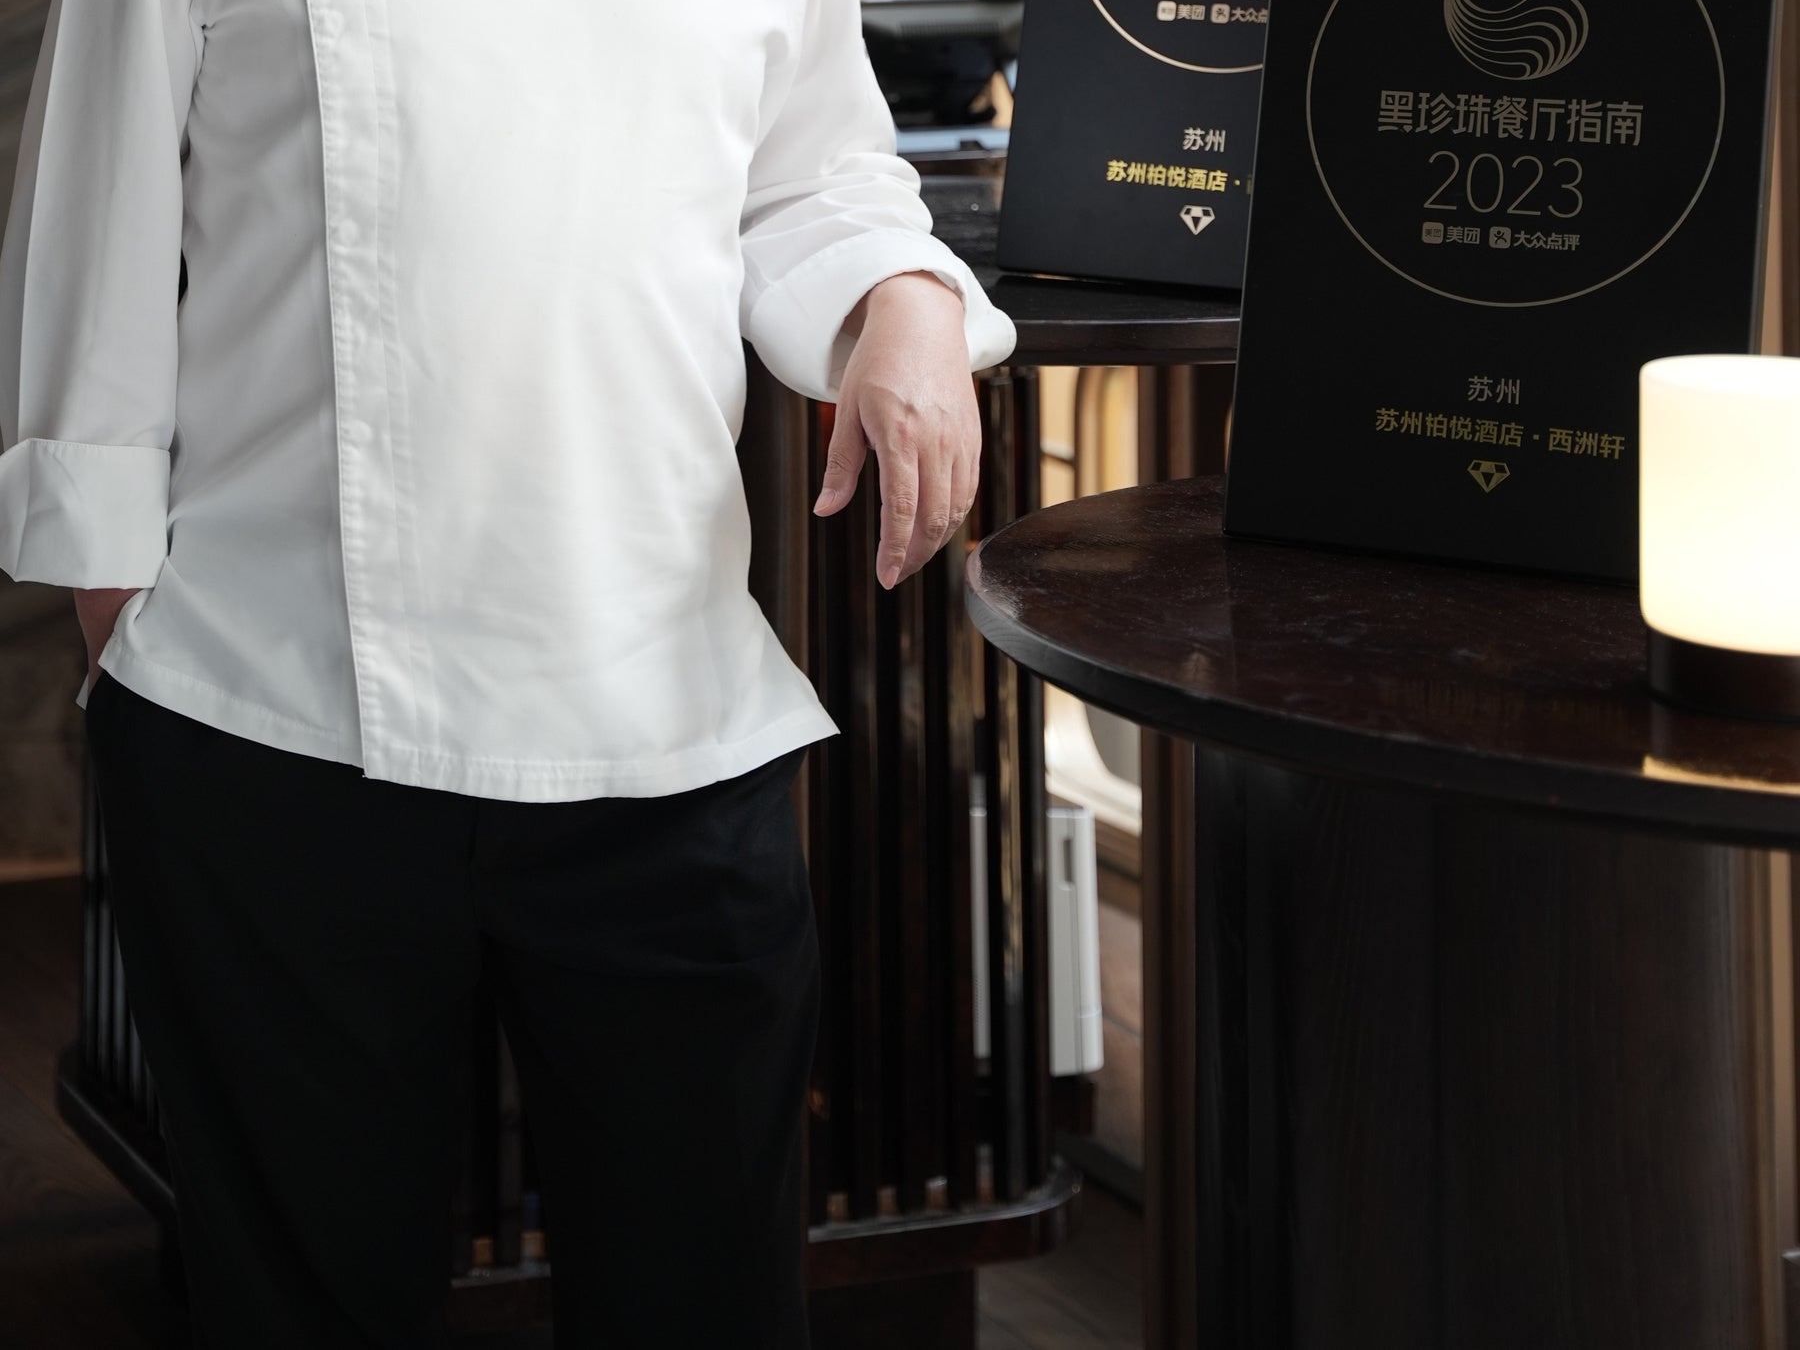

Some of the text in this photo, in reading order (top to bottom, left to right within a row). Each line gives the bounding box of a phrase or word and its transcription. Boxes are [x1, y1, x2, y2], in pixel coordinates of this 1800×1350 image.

[1177, 4, 1206, 21] 美团
[1377, 89, 1644, 147] 黑珍珠餐厅指南
[1182, 127, 1226, 153] 苏州
[1423, 150, 1583, 219] 2023
[1445, 225, 1481, 245] 美团
[1513, 230, 1581, 251] 大众点评
[1467, 375, 1521, 405] 苏州
